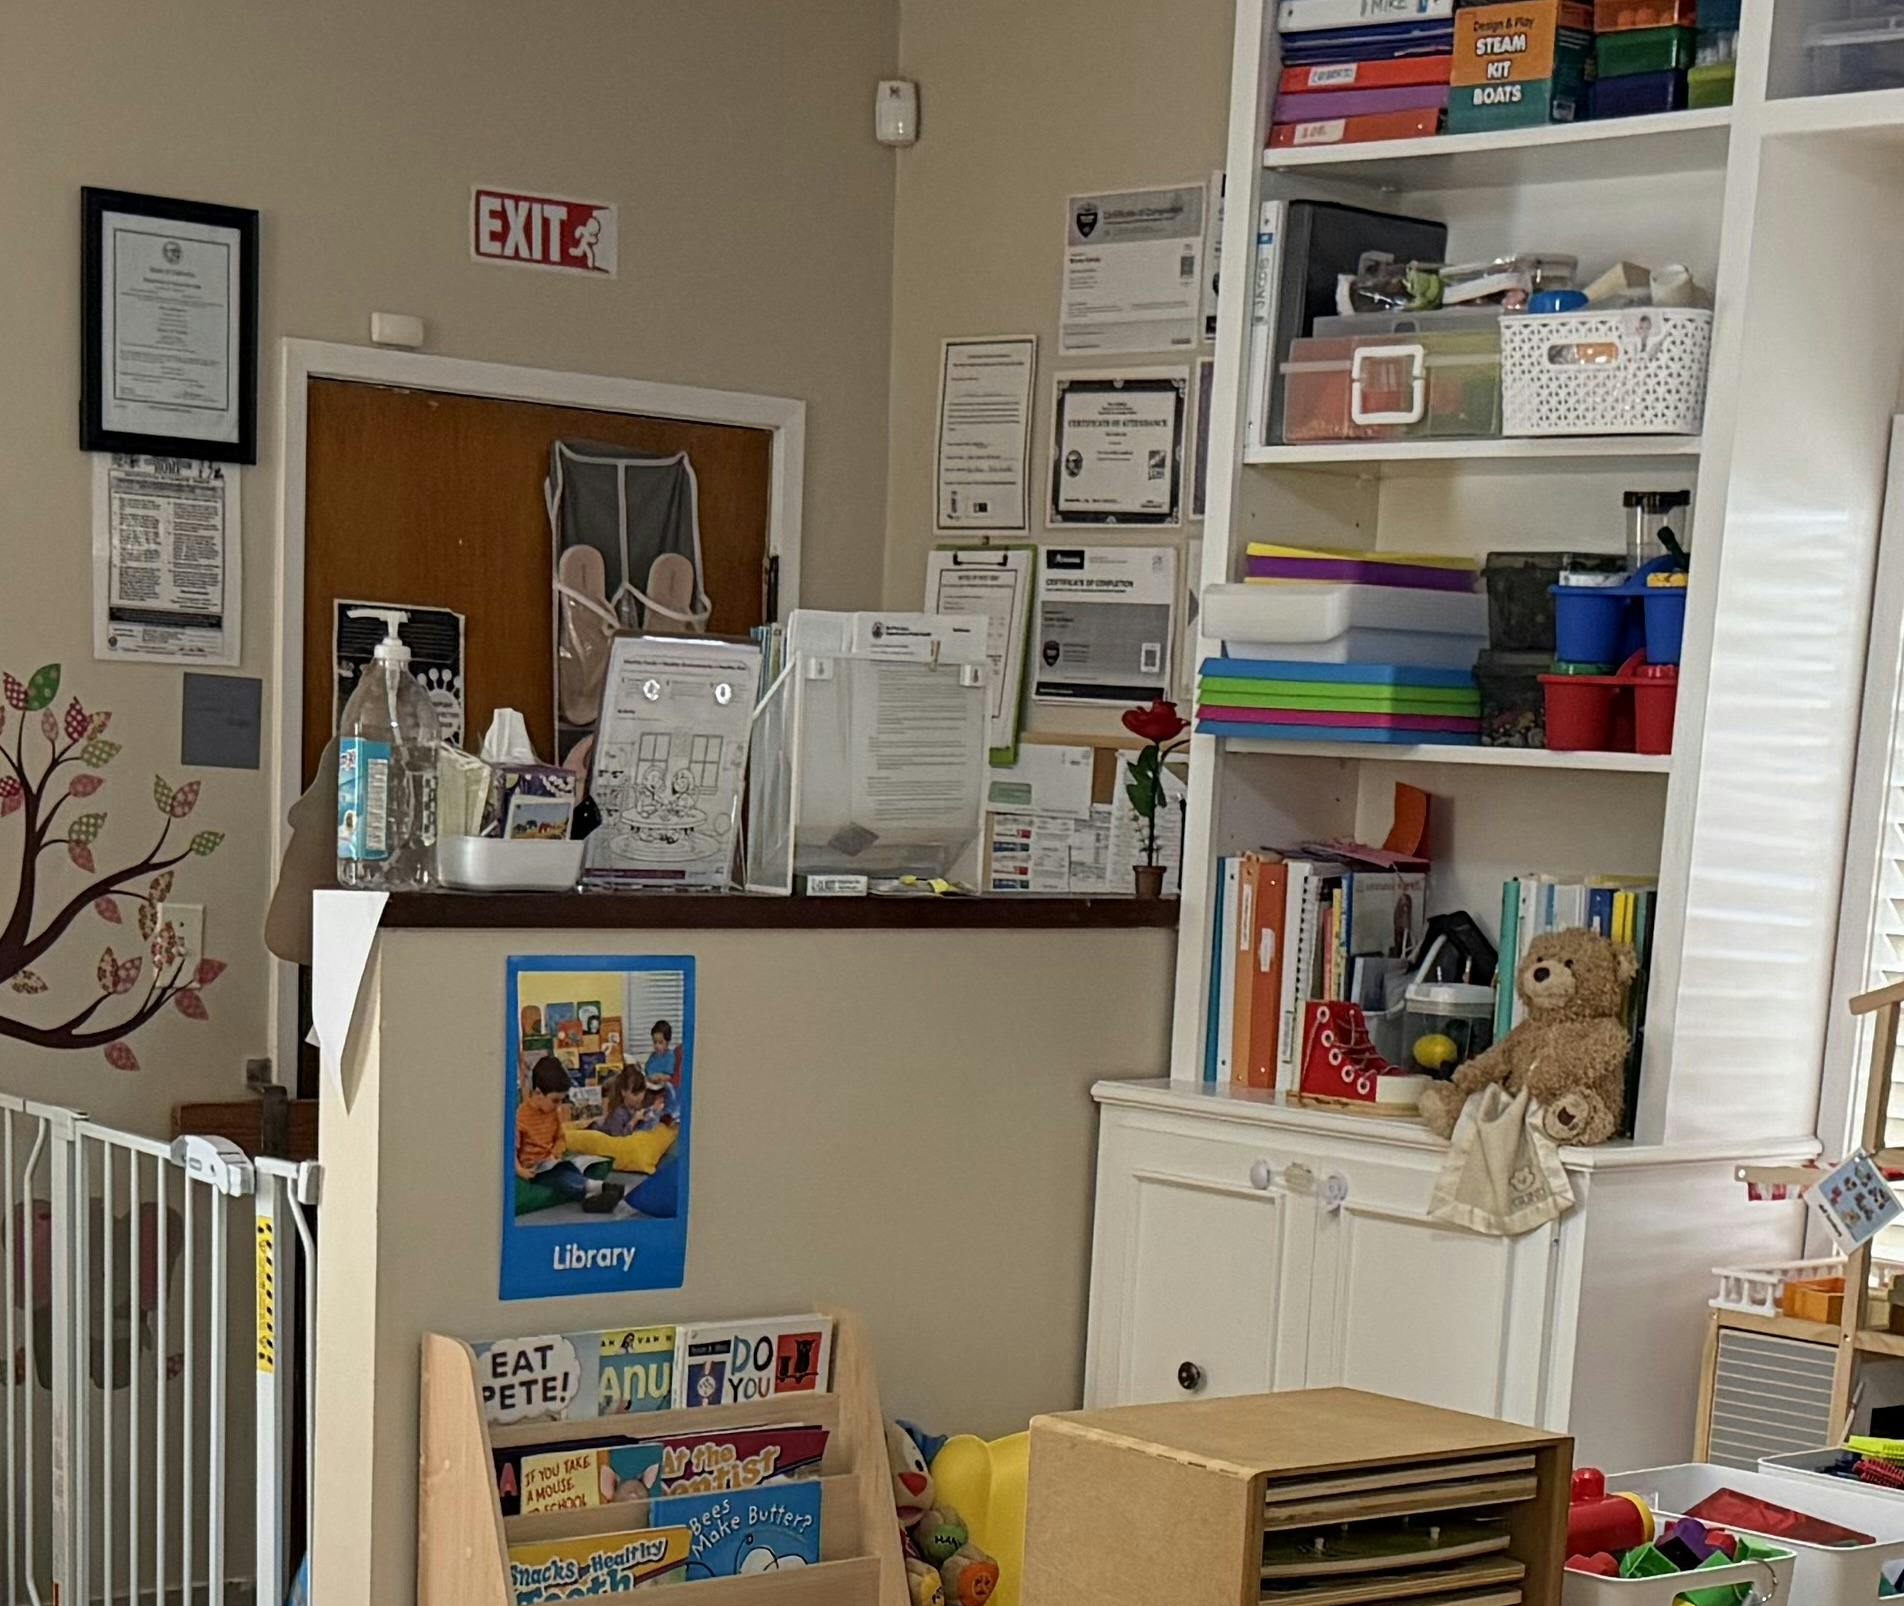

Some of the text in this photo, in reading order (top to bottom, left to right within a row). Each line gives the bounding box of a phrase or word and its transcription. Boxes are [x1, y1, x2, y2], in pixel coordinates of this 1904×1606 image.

[1475, 35, 1526, 55] STEAM
[1486, 60, 1511, 80] KIT
[1473, 85, 1521, 106] BOATS
[479, 195, 567, 262] EXIT
[553, 1243, 636, 1272] Library
[491, 1344, 554, 1379] EAT
[731, 1336, 774, 1376] DO
[482, 1371, 570, 1410] PETE!
[728, 1377, 771, 1403] YOU
[524, 1455, 591, 1487] IF YOU TAKE
[527, 1477, 575, 1506] A MOUSE
[689, 1498, 731, 1536] Bees
[691, 1504, 812, 1560] Make Butter?
[590, 1538, 666, 1573] Healthy
